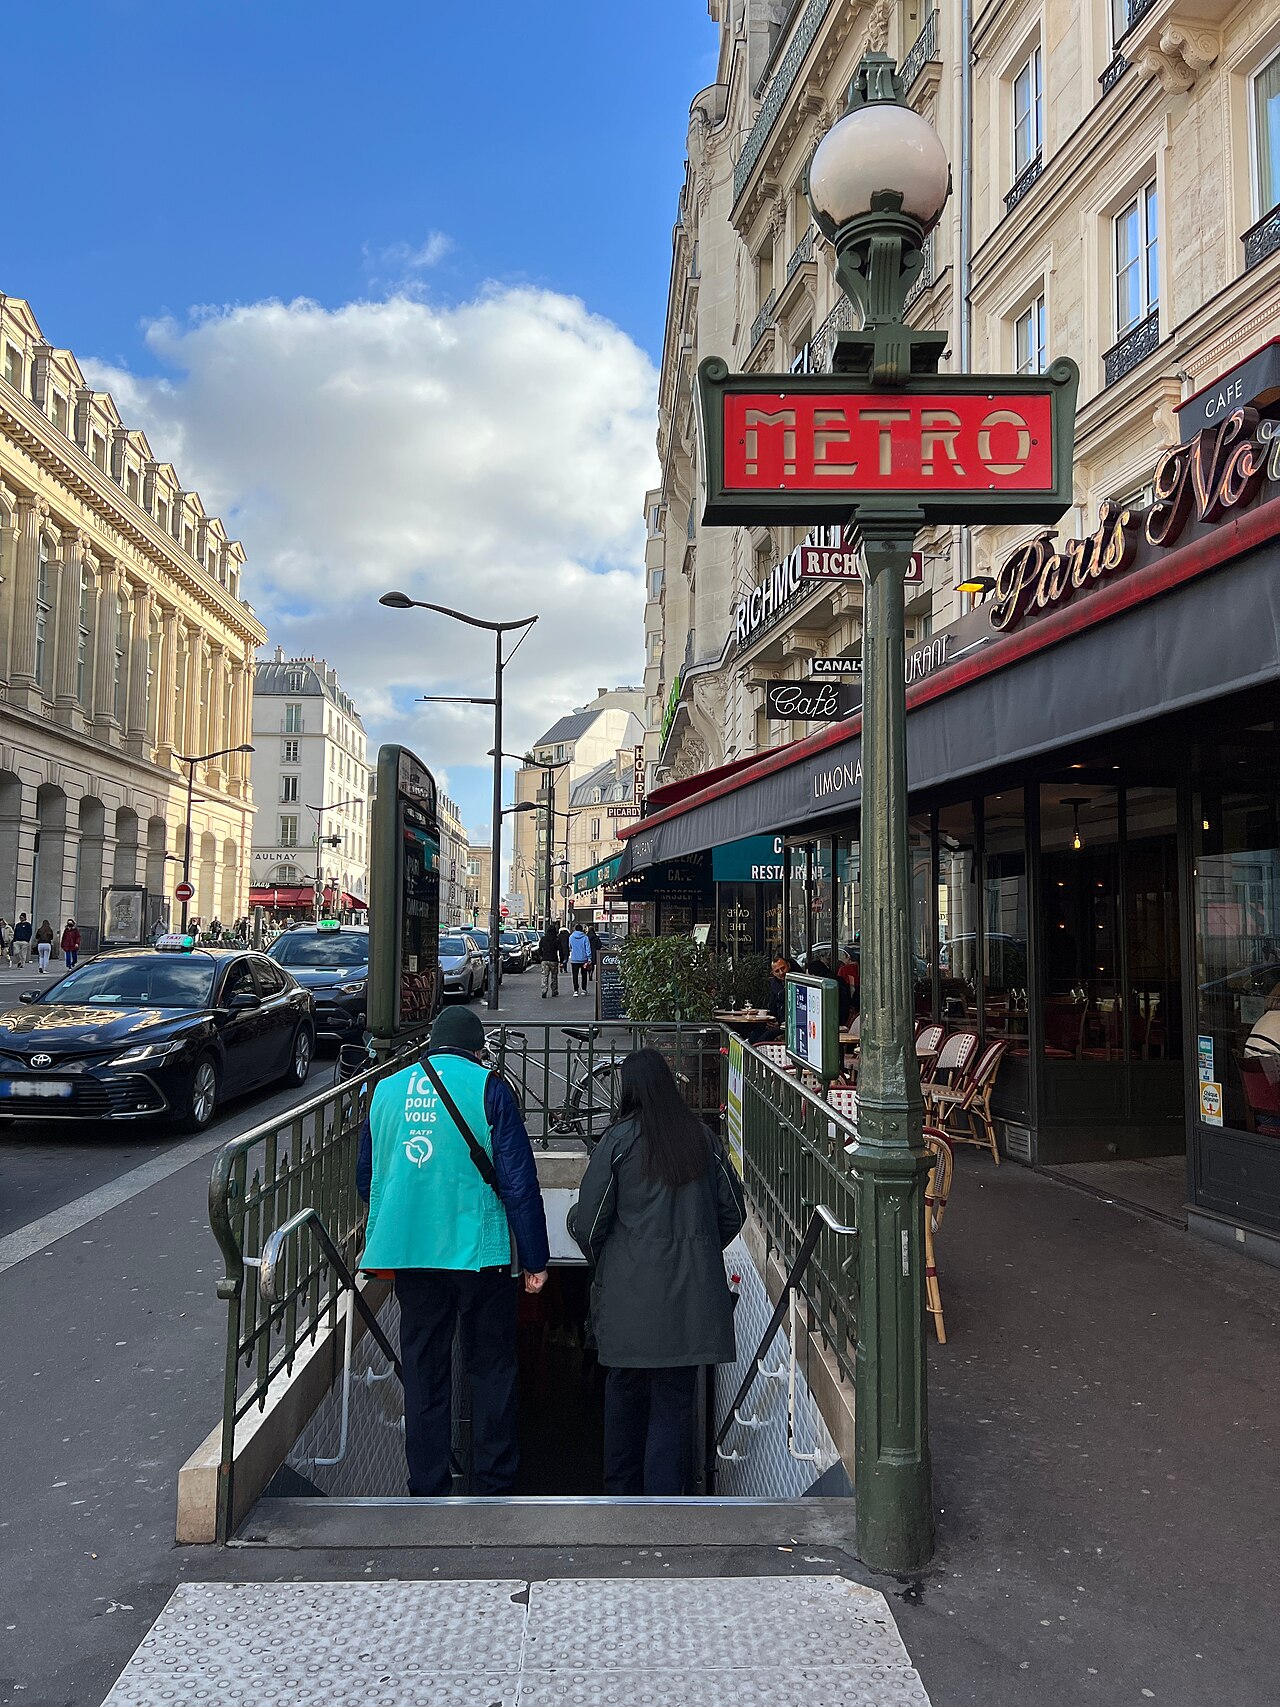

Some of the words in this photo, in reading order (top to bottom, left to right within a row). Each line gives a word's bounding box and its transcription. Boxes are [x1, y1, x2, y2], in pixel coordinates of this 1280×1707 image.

[1205, 379, 1243, 418] CAFE
[745, 408, 1030, 476] METRO
[988, 499, 1134, 632] Paris
[904, 633, 949, 684] URANT
[769, 685, 839, 717] Café
[634, 745, 645, 805] HOTEL
[814, 758, 863, 798] LIMONA
[405, 1097, 438, 1111] pour
[405, 1112, 437, 1122] vous
